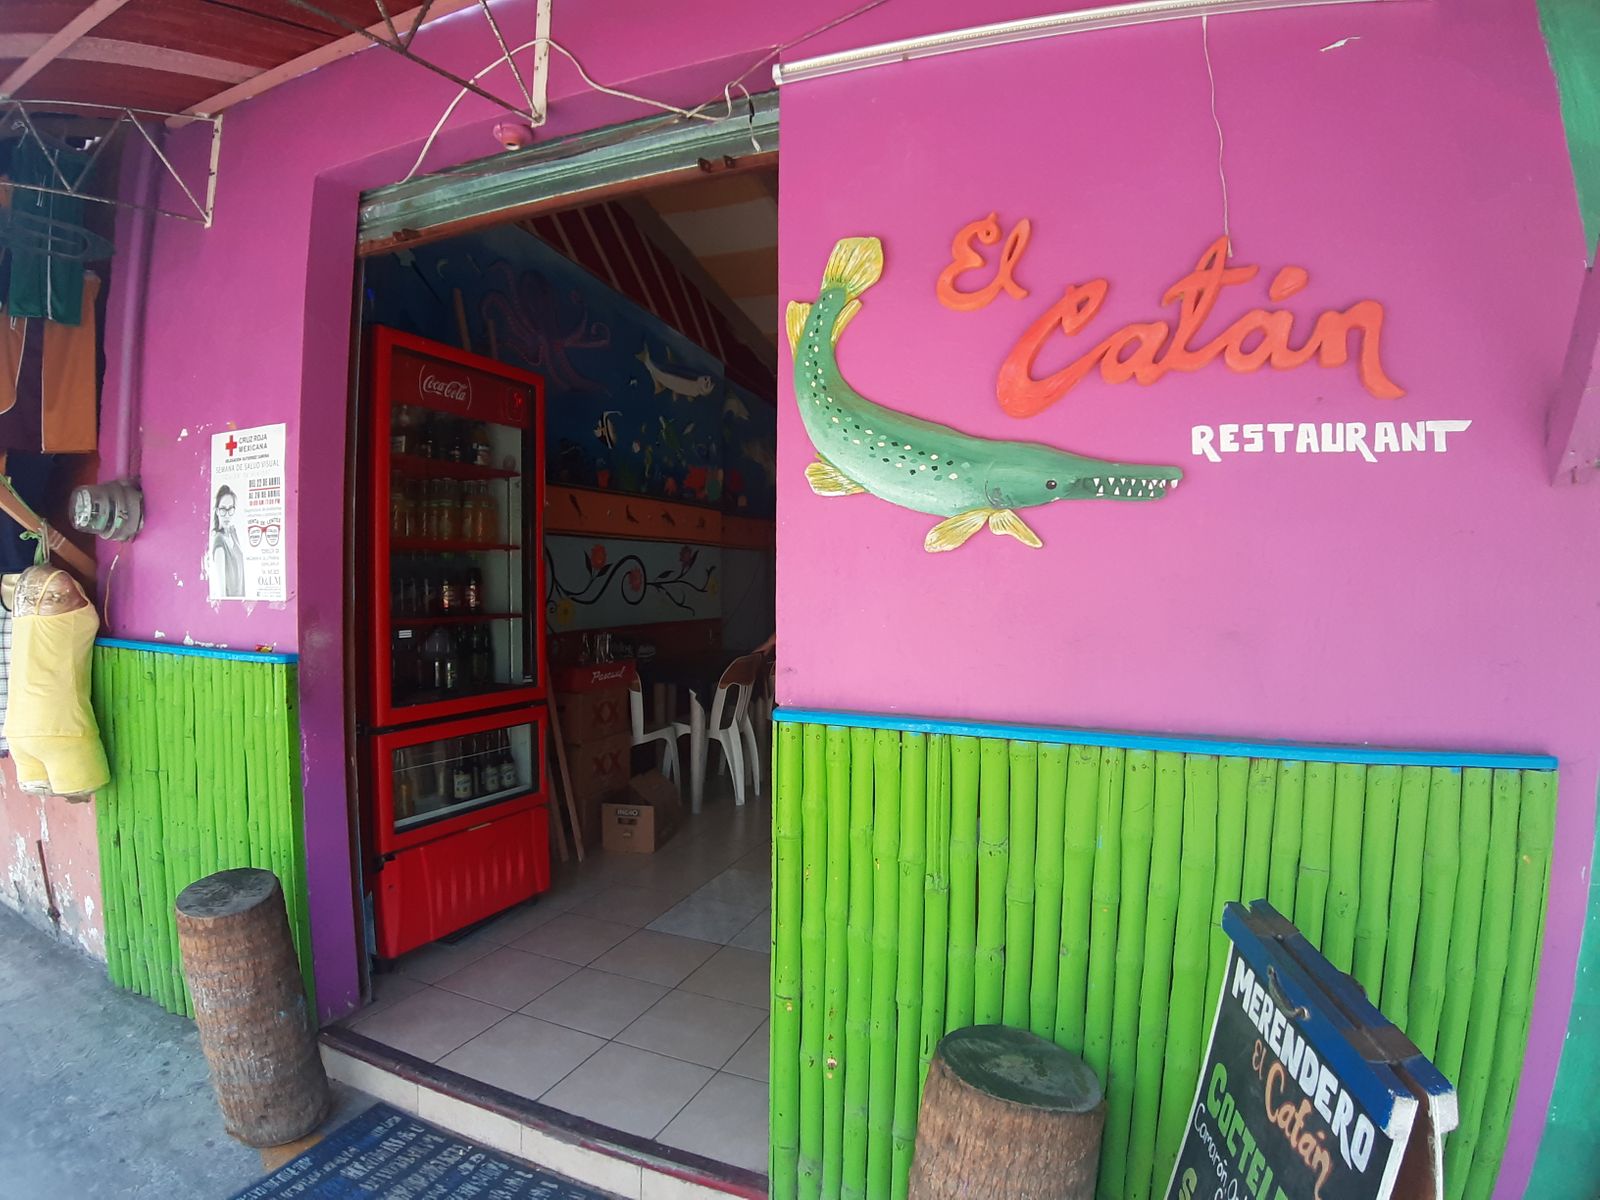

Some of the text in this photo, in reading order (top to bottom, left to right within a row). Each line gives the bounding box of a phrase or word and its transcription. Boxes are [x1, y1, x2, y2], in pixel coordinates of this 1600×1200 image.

[936, 211, 1030, 311] El
[996, 235, 1406, 418] Catán
[238, 442, 268, 453] MEXICANA
[239, 433, 268, 445] CRUZ ROJA
[1191, 419, 1474, 463] RESTAURANT
[1231, 957, 1376, 1173] MERENDERO
[1252, 1038, 1266, 1081] El
[1265, 1061, 1333, 1200] Catán
